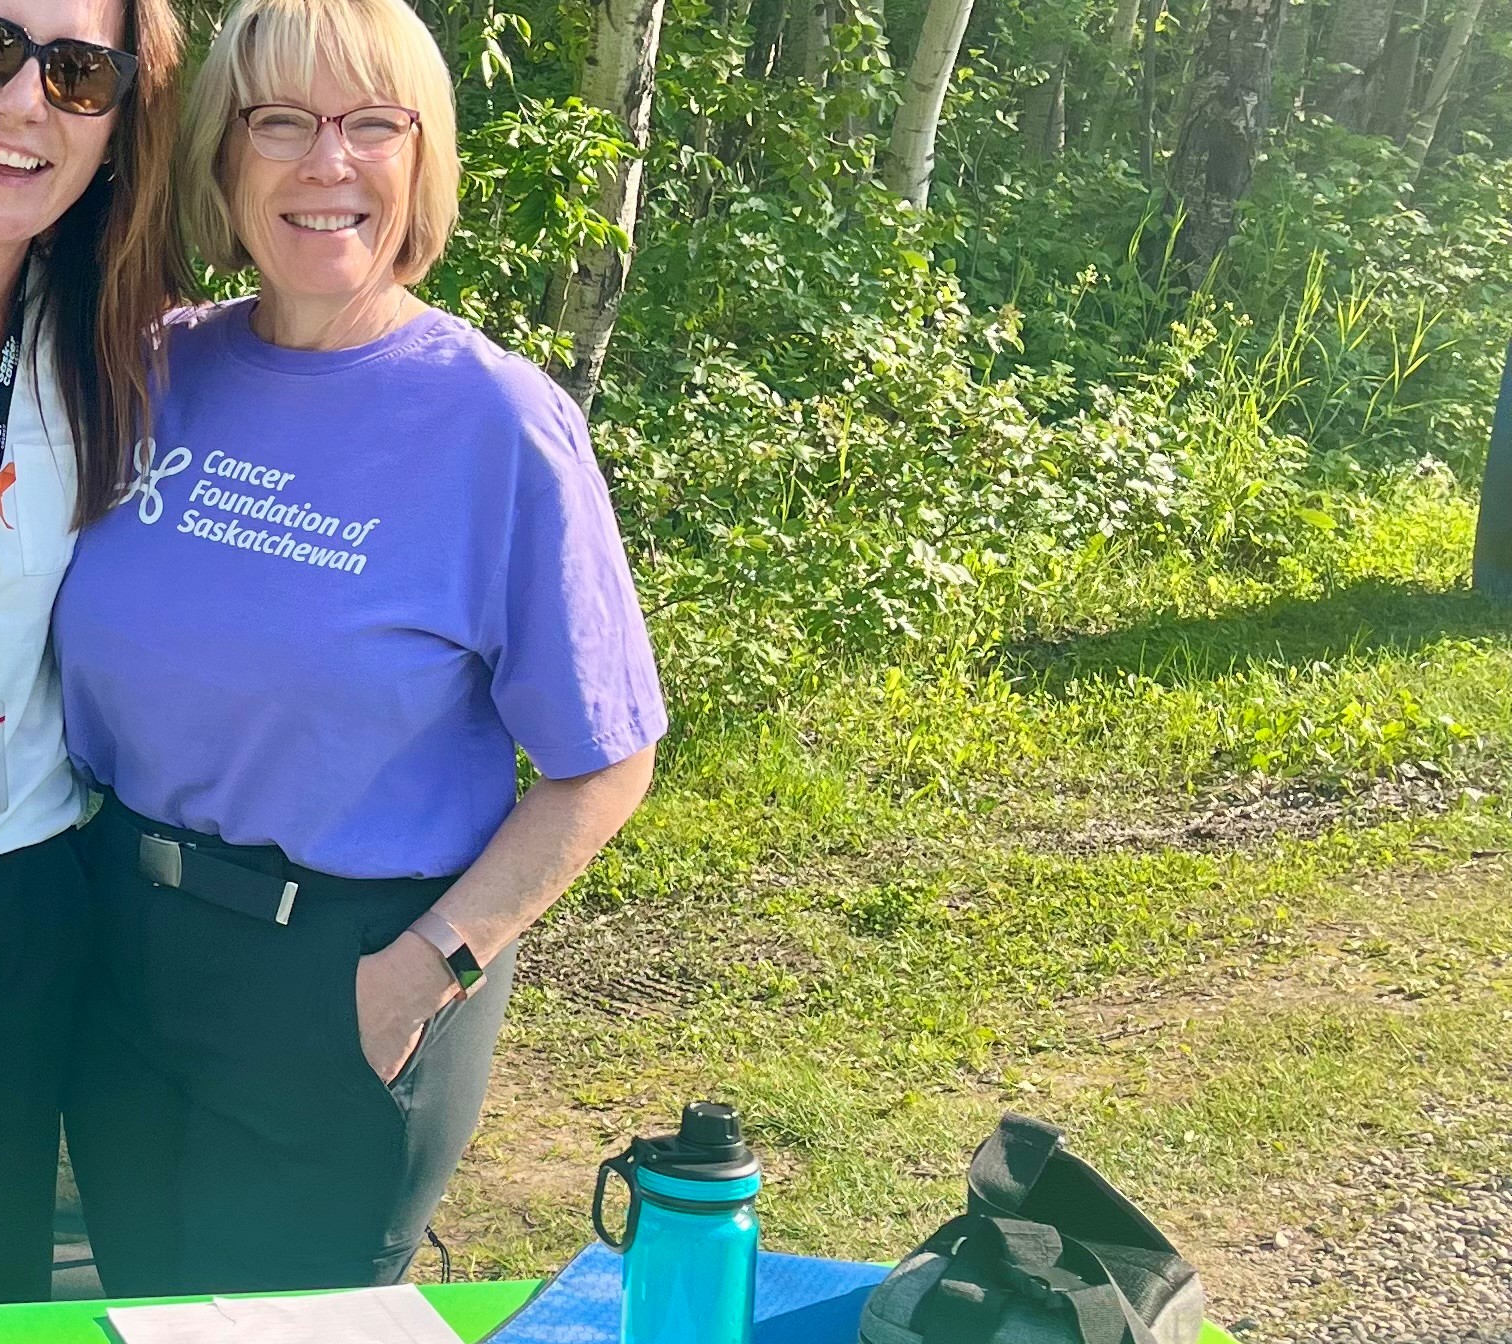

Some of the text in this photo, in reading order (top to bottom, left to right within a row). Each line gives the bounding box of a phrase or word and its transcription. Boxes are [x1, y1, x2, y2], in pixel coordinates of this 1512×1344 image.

[202, 449, 296, 492] Cancer
[176, 508, 368, 575] Saskatchewan
[188, 478, 381, 548] Foundation of
